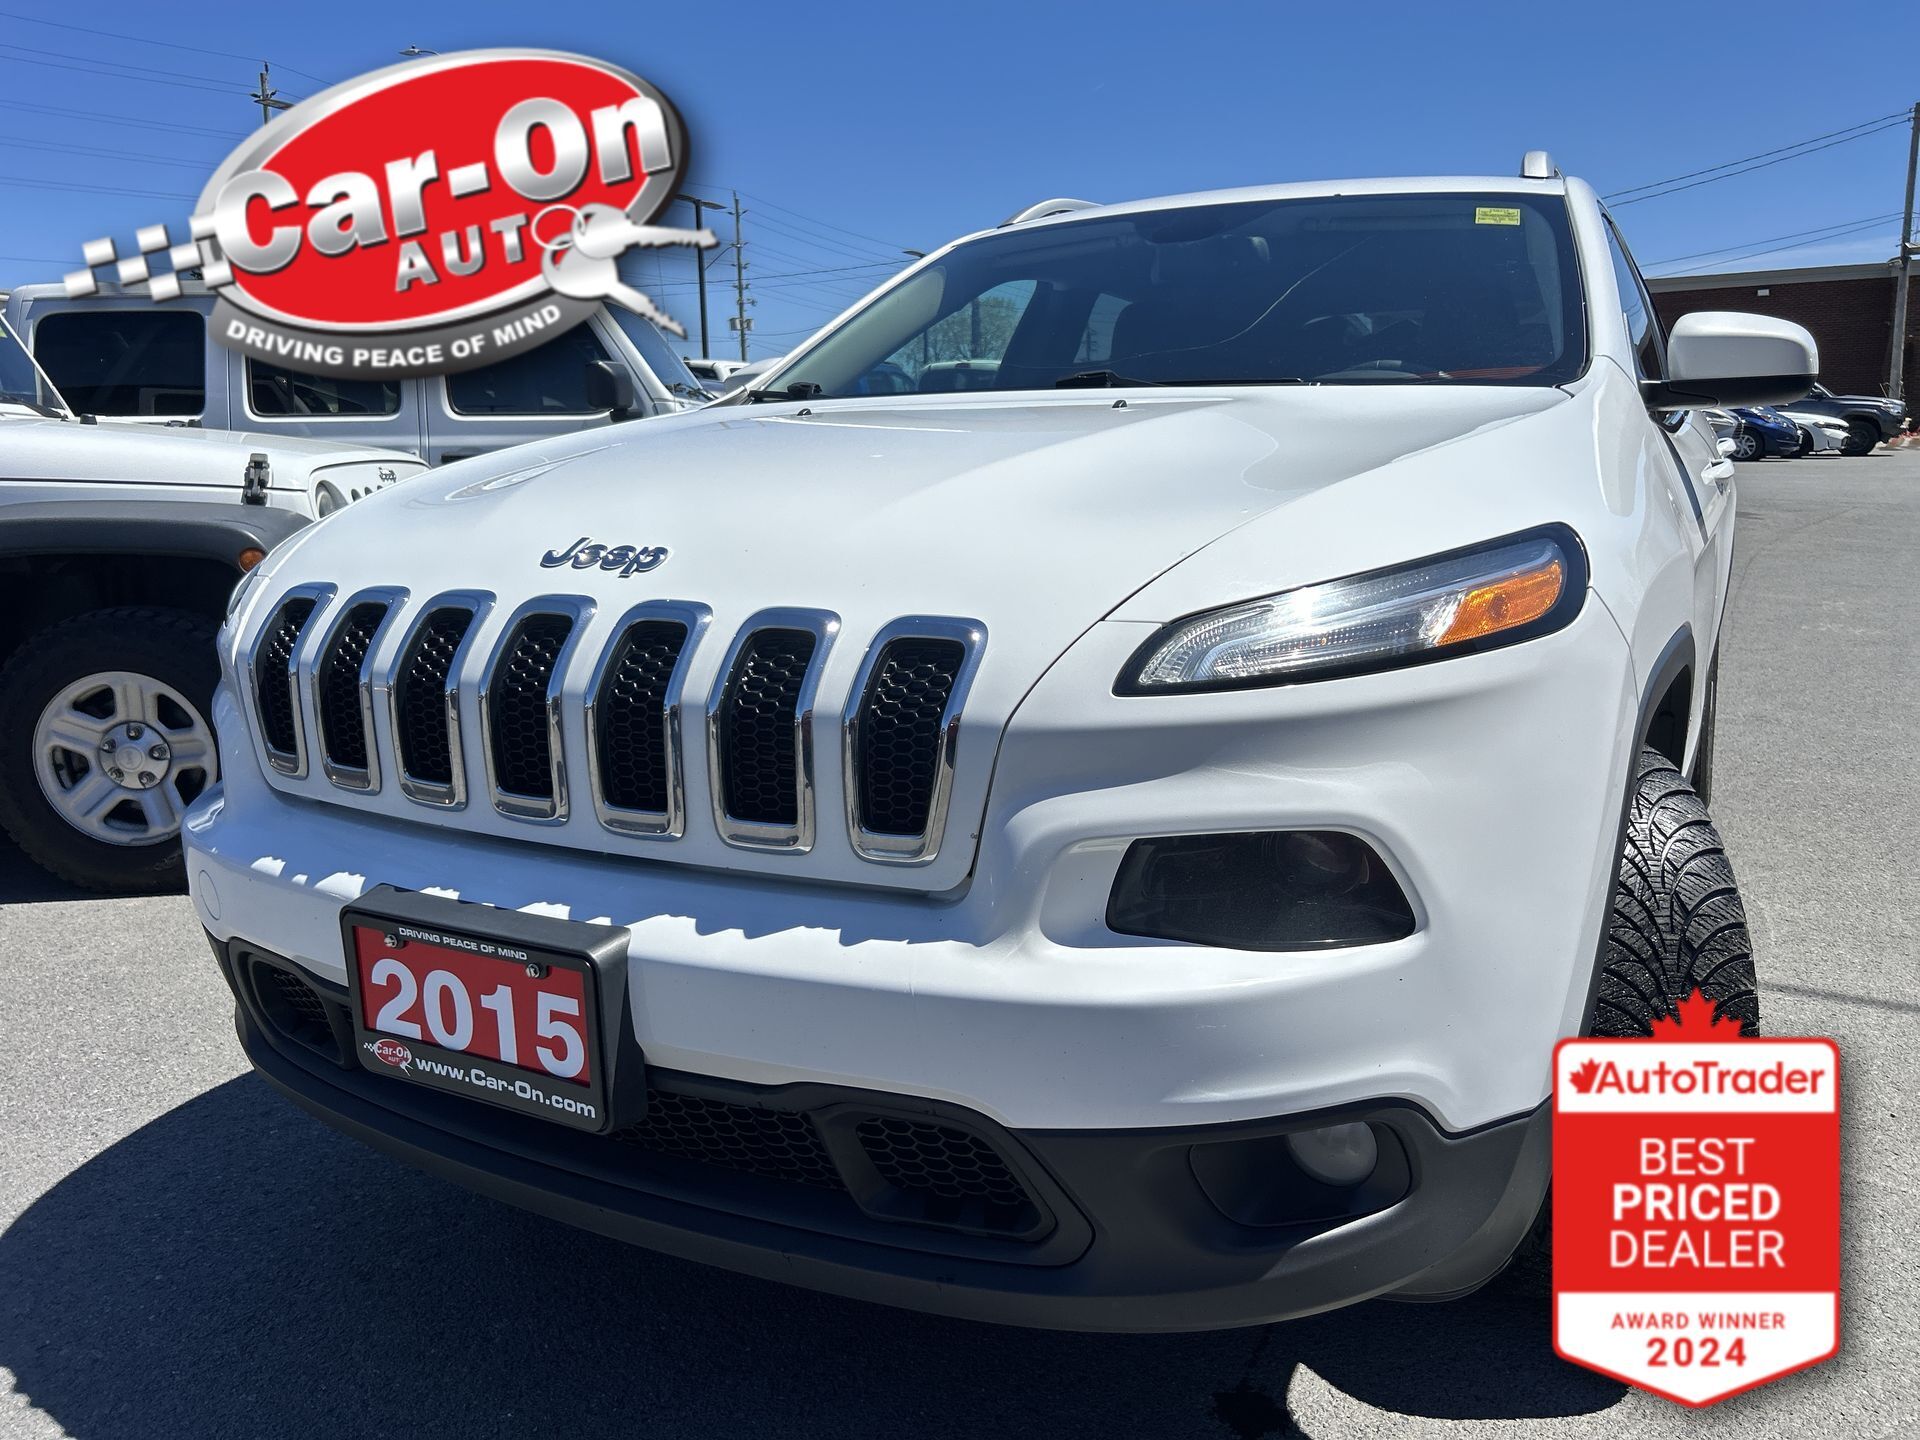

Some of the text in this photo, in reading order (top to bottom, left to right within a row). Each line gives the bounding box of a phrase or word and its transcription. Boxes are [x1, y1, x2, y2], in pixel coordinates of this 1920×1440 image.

[540, 537, 668, 578] Jeep
[399, 927, 528, 961] DRIVING PEACE OF MIND
[371, 958, 585, 1078] 2015
[374, 1043, 411, 1058] Car-On
[415, 1057, 596, 1119] www.Car-On.com
